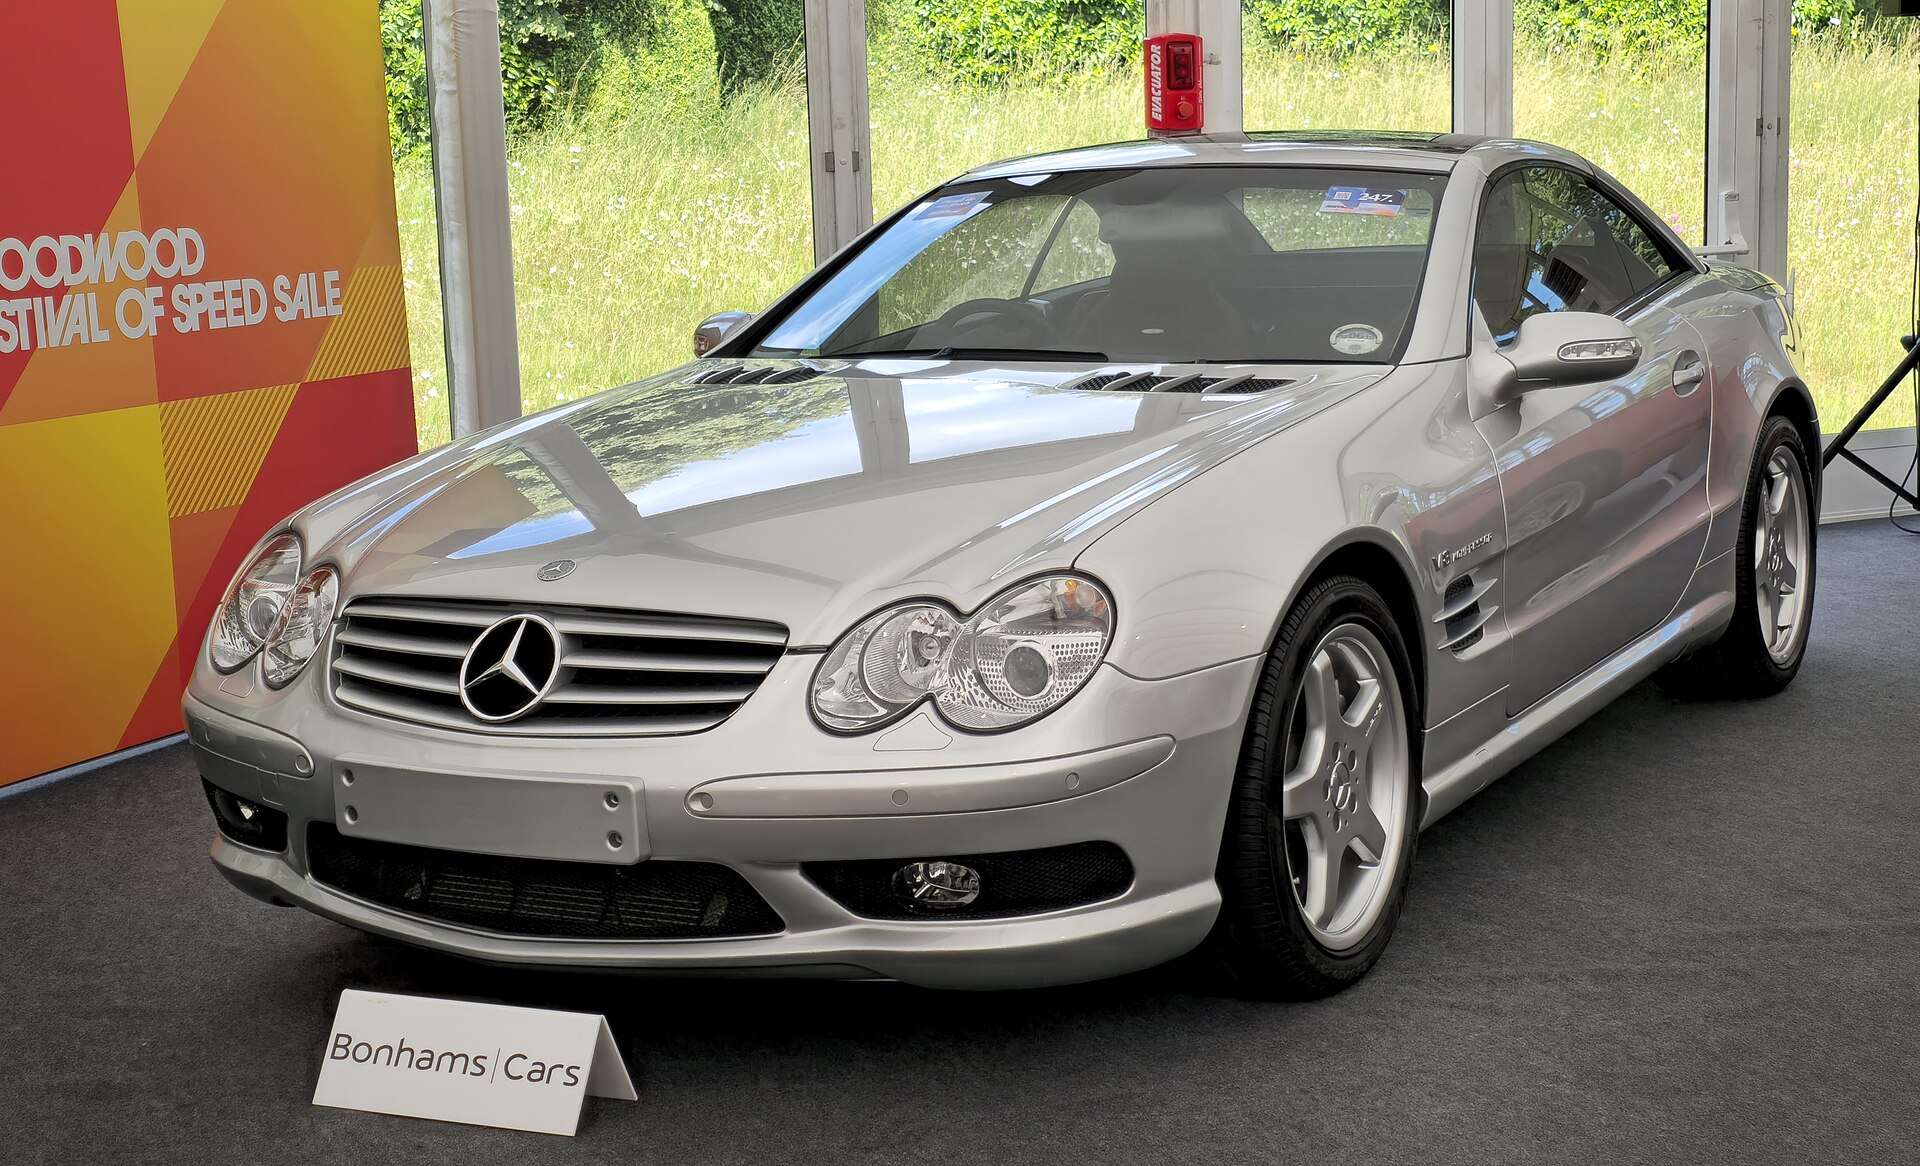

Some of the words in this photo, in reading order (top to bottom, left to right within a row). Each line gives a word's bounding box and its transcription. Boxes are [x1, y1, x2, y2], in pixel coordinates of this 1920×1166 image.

[1150, 44, 1162, 121] EVACUATOR
[115, 286, 165, 340] OF
[171, 277, 268, 334] SPEED
[273, 270, 343, 323] SALE
[329, 1032, 488, 1078] Bonhams
[503, 1053, 581, 1087] Cars
